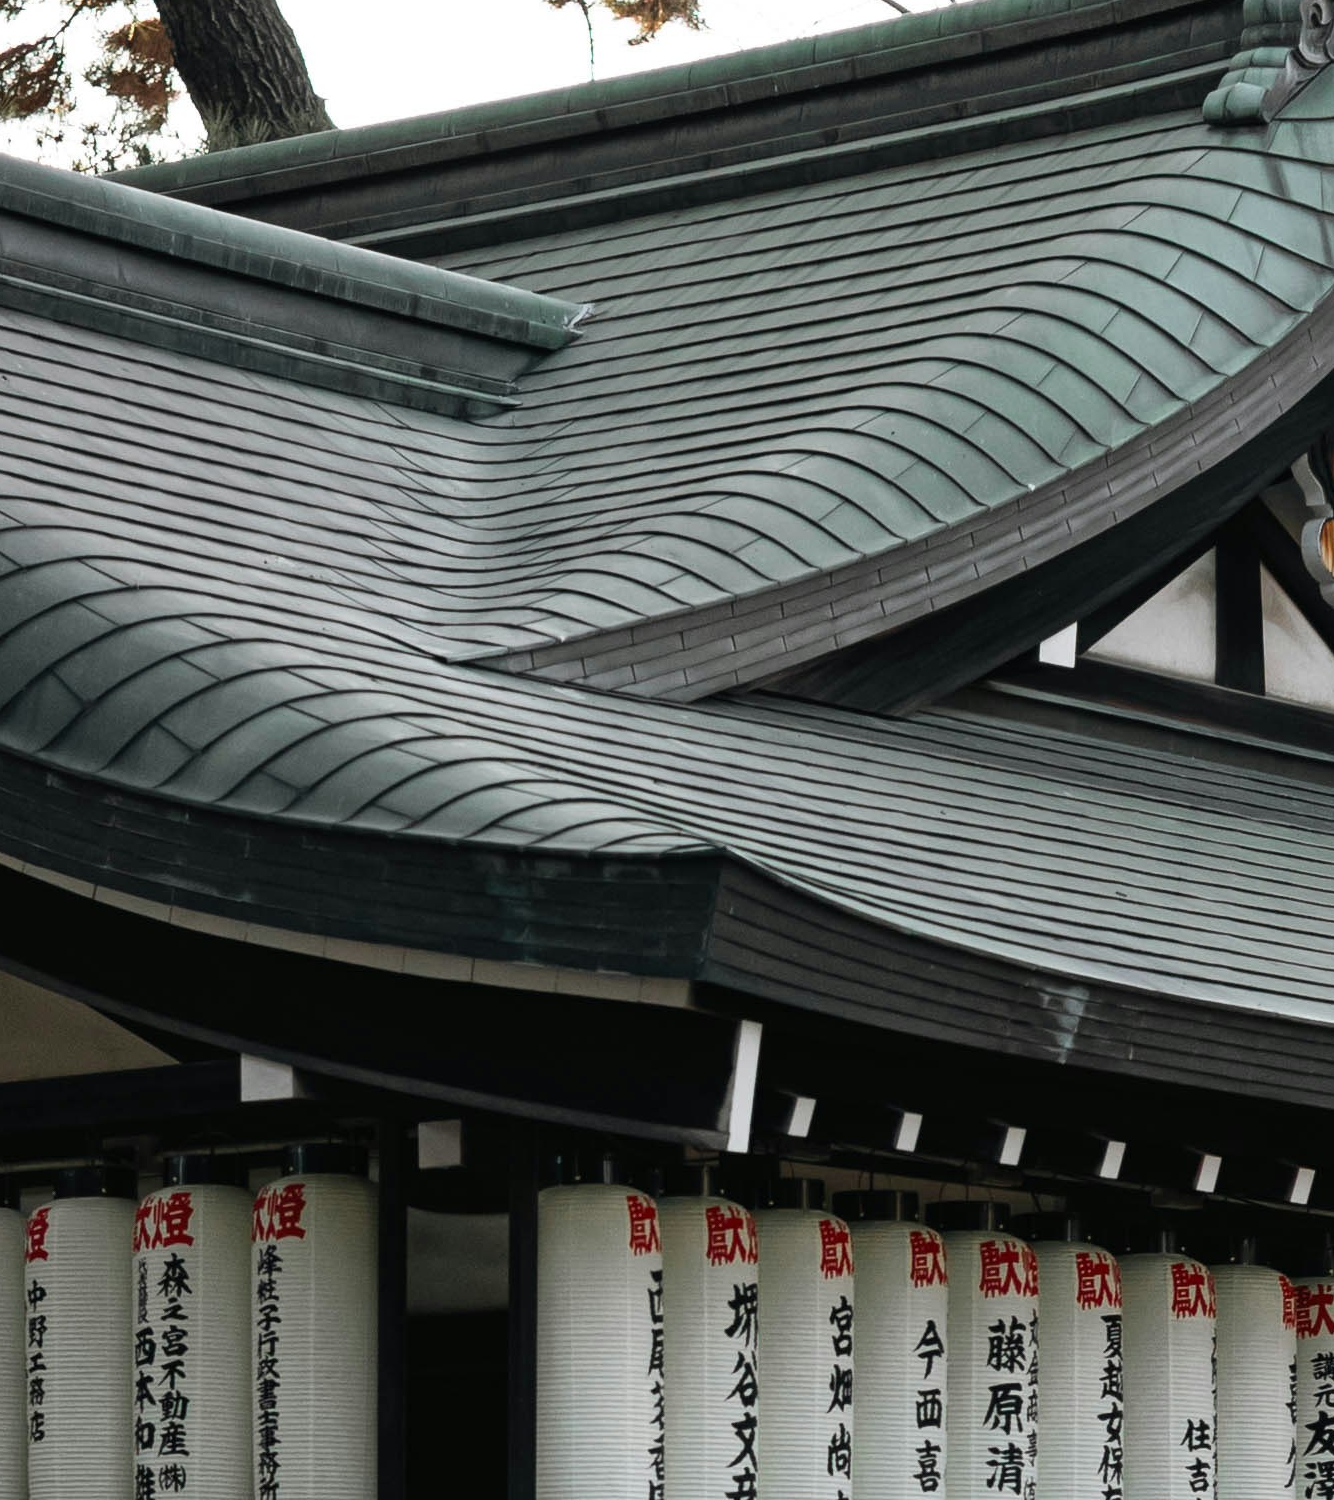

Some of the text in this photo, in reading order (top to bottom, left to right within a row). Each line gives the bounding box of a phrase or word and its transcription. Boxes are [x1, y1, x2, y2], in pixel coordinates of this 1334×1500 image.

[27, 1280, 47, 1443] 中野工務店
